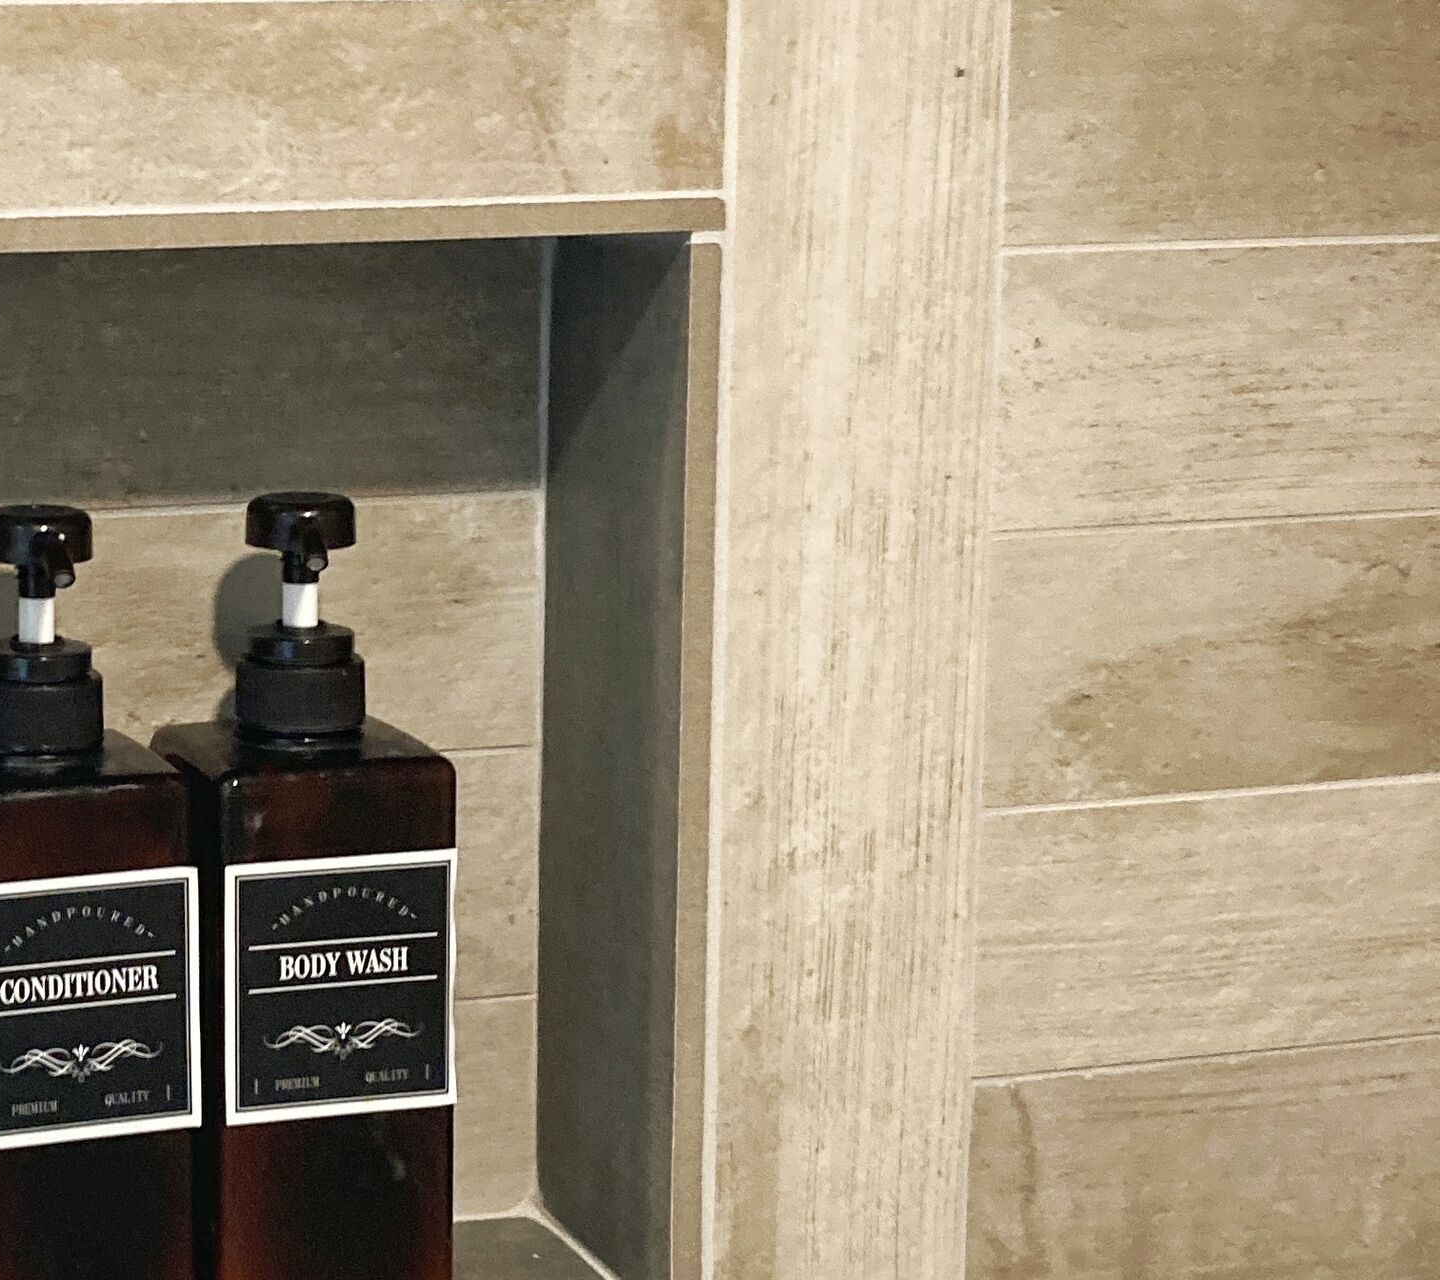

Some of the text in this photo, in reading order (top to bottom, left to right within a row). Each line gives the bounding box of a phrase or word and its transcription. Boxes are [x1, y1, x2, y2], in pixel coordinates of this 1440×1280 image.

[279, 947, 409, 981] BODY WASH
[0, 964, 159, 1005] CONDITIONER
[11, 1089, 150, 1116] PREMIUM QUALITY
